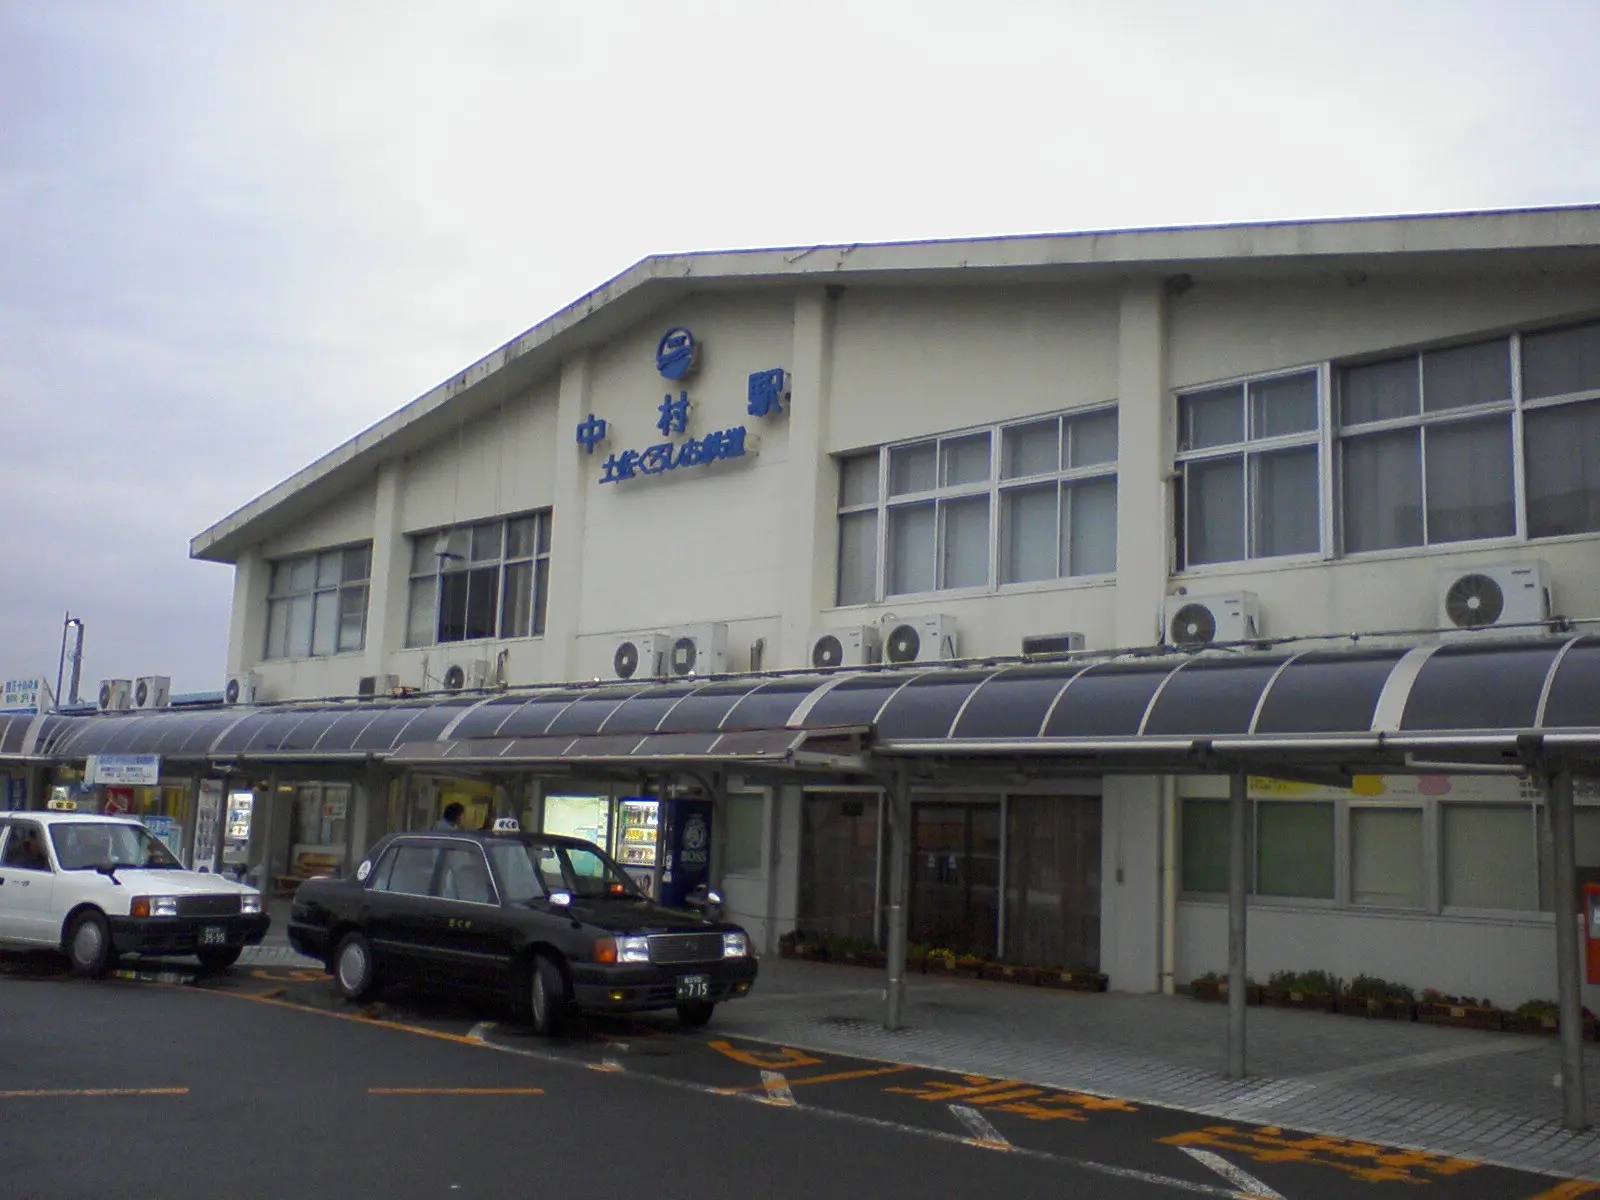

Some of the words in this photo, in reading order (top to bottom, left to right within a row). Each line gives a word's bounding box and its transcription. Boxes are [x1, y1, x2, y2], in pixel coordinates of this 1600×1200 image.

[576, 368, 784, 454] 中村駅
[681, 849, 707, 863] BOSS
